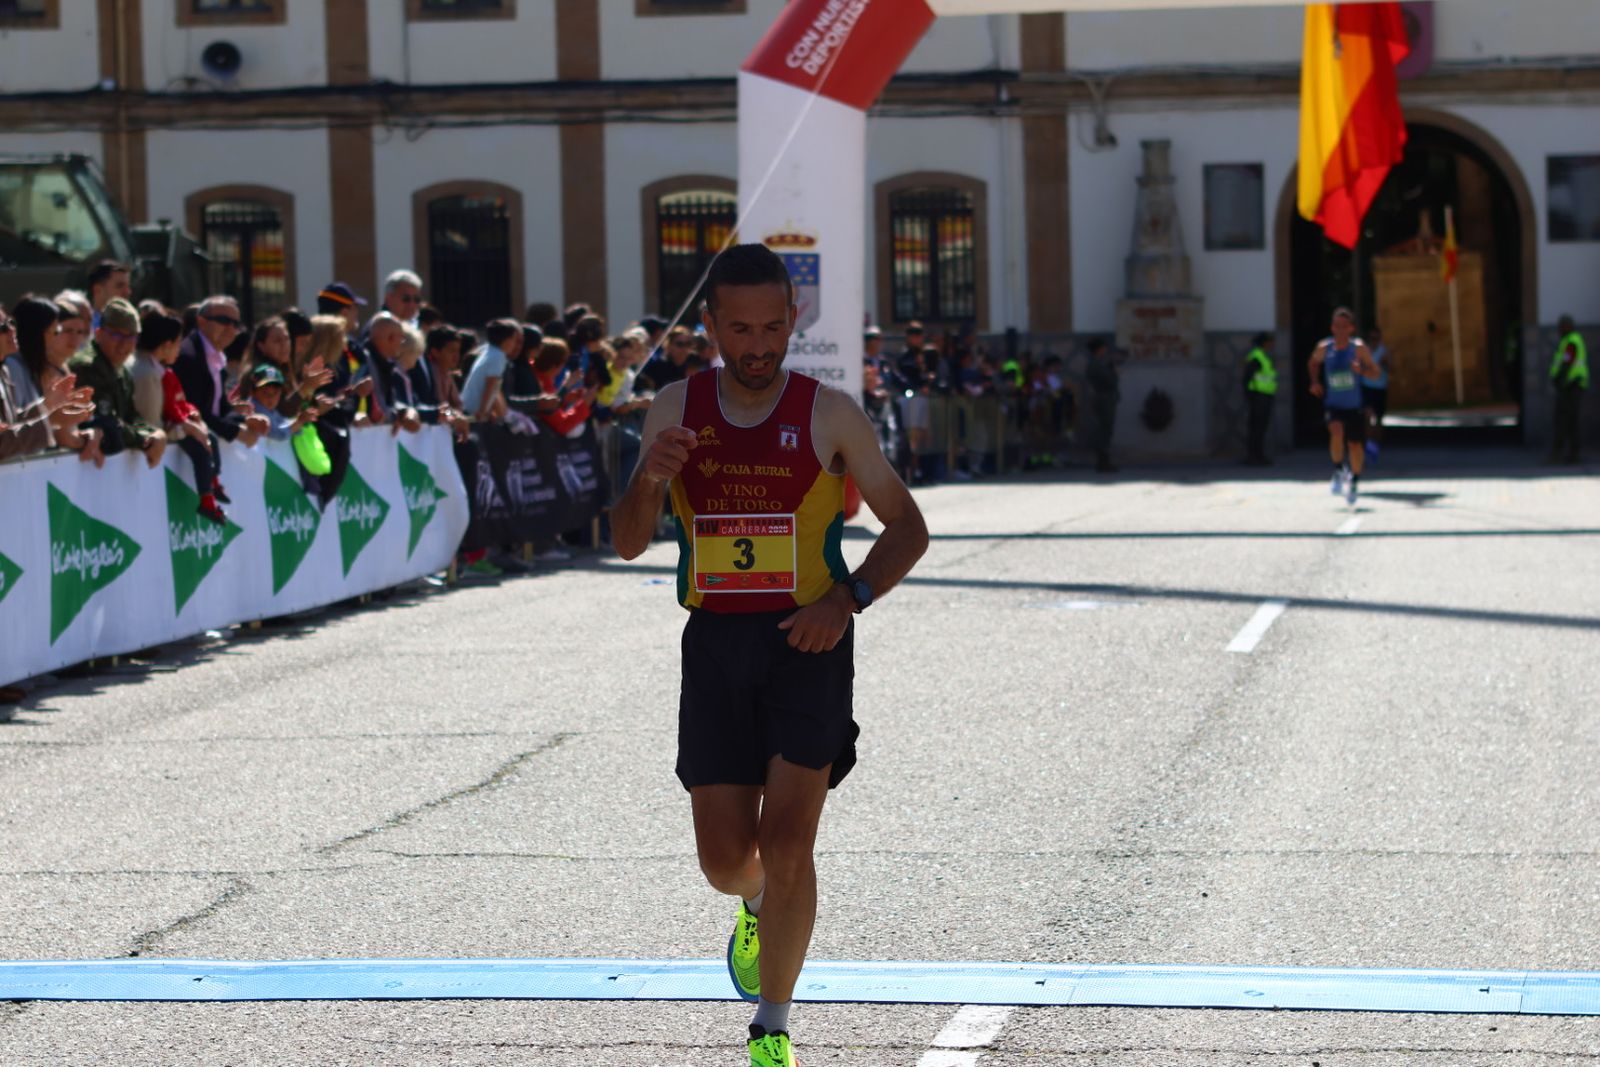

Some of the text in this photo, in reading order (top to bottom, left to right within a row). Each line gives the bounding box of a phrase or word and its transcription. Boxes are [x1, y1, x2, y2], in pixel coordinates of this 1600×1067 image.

[785, 0, 848, 69] CON NUE
[788, 335, 839, 356] ación
[722, 464, 793, 477] CAJA RURAL
[721, 483, 767, 497] VINO
[706, 498, 783, 512] DE TORO
[721, 526, 767, 535] CARRERA
[733, 537, 755, 571] 3
